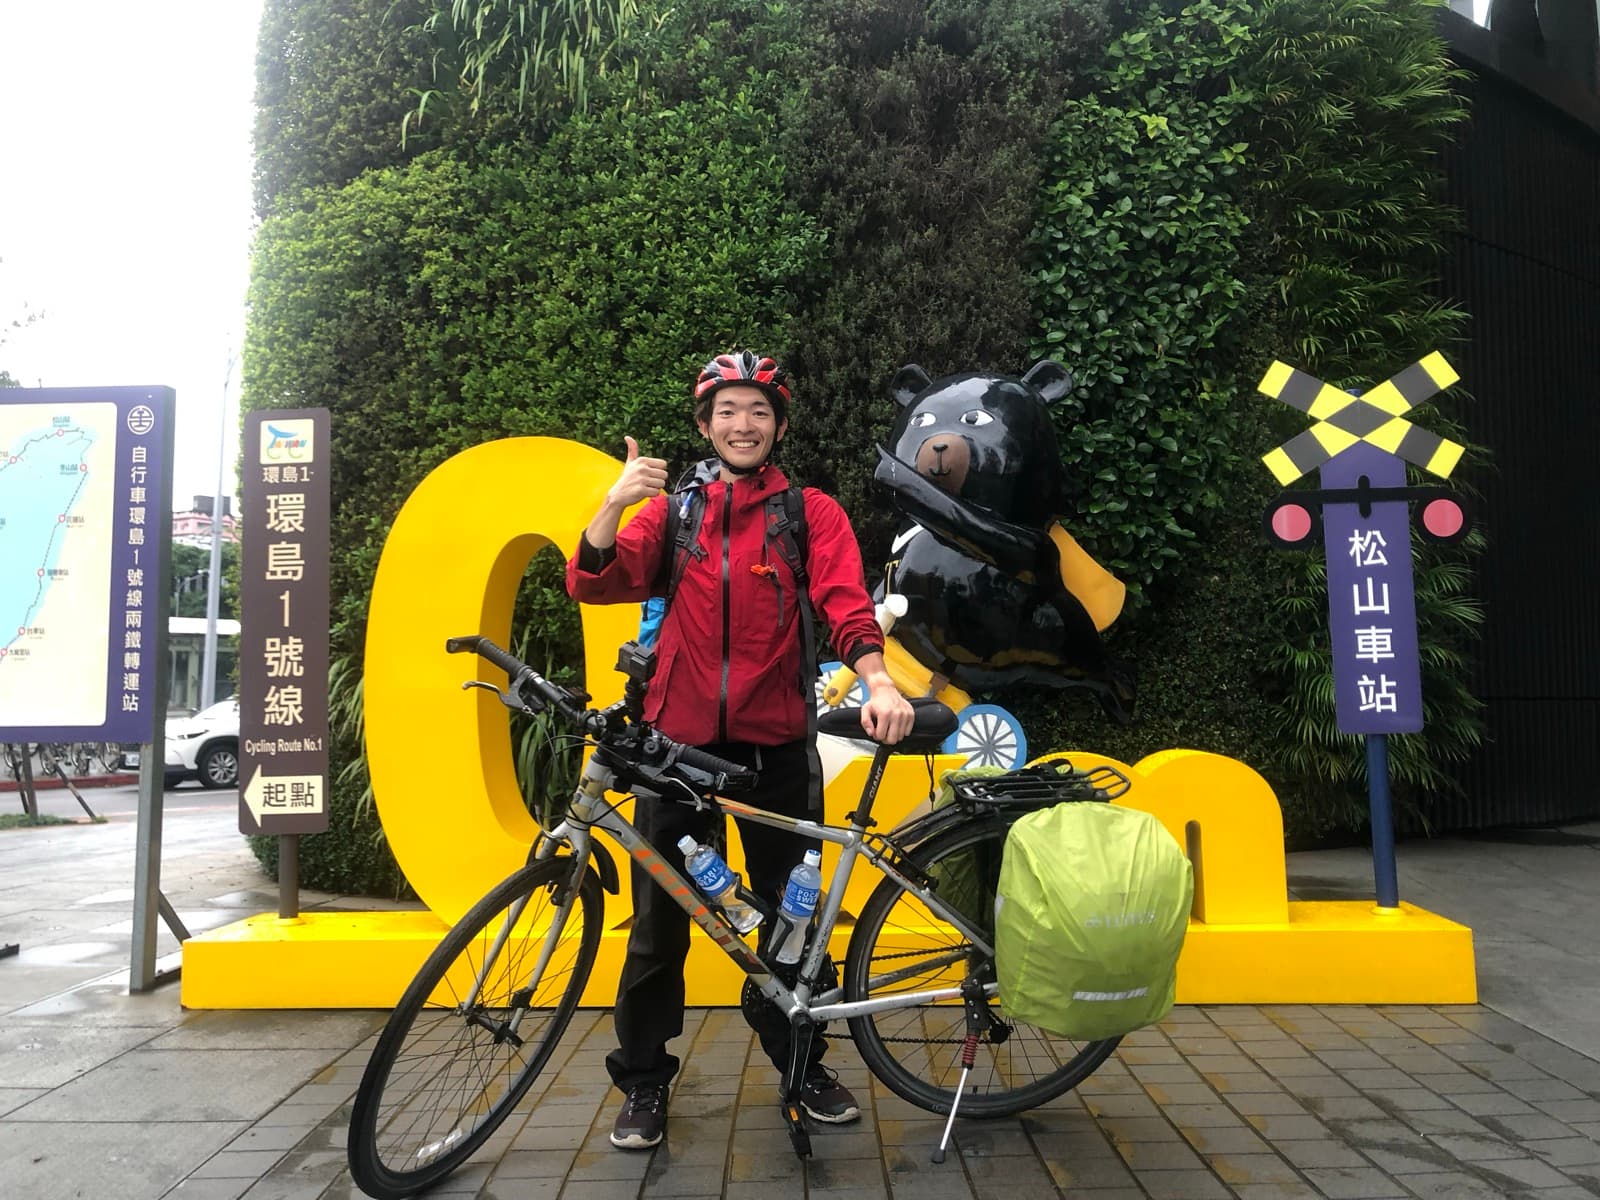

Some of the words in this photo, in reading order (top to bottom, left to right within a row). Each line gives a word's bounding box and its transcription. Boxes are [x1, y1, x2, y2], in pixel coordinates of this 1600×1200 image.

[122, 445, 148, 712] 自行車環島1號線兩鐵轉運站
[264, 493, 306, 726] 環島1號線
[1348, 529, 1397, 713] 松山車站
[244, 739, 277, 756] Cycling
[277, 738, 303, 752] Route
[303, 737, 322, 752] No.1
[262, 781, 316, 808] 起點
[869, 764, 883, 799] GIANT
